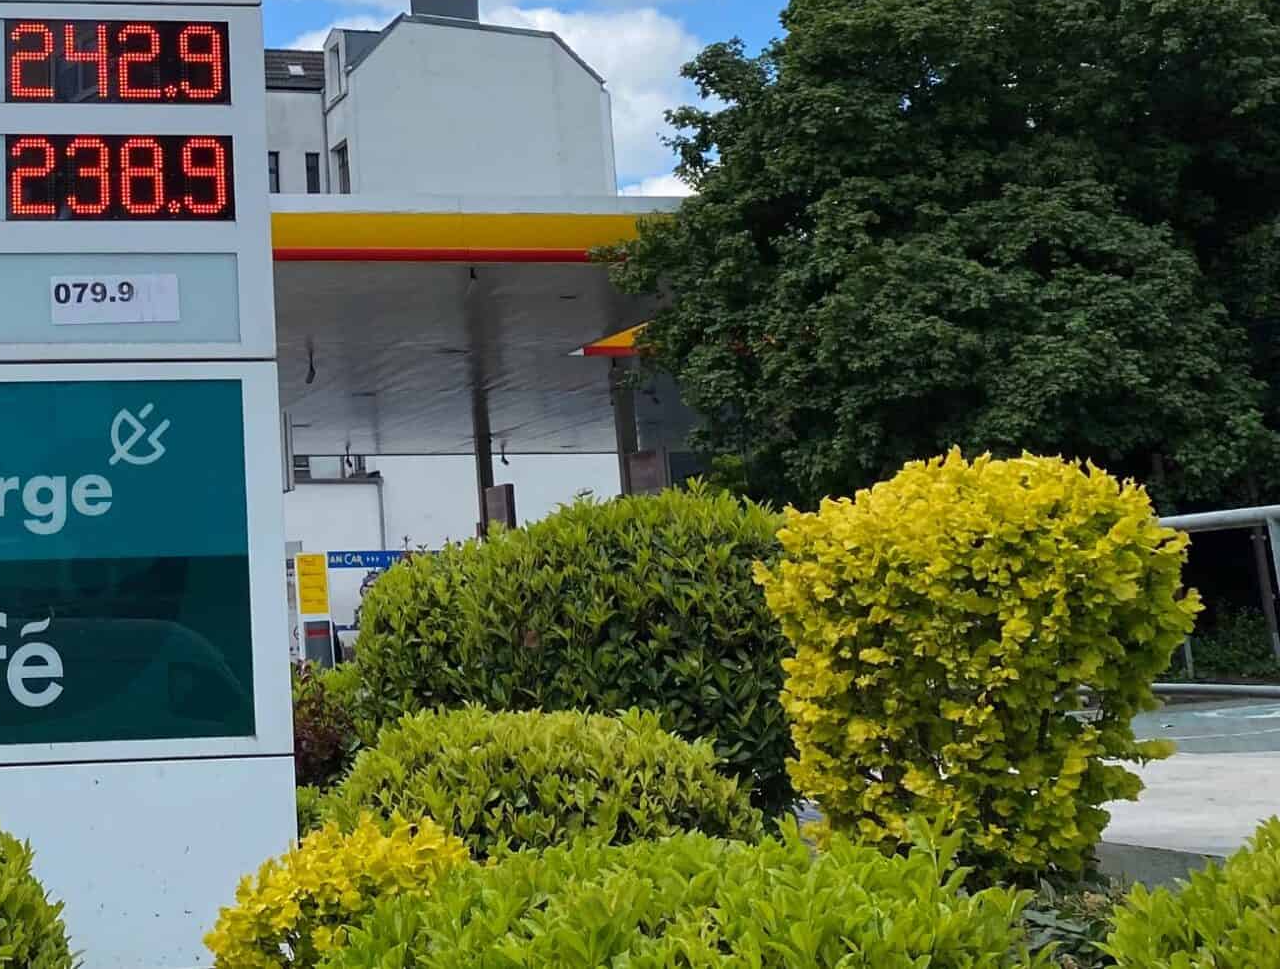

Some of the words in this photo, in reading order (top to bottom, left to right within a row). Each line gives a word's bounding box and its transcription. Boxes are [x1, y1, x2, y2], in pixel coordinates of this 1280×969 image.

[11, 22, 222, 99] 242.9
[11, 137, 226, 215] 238.9
[53, 281, 134, 304] 079.9
